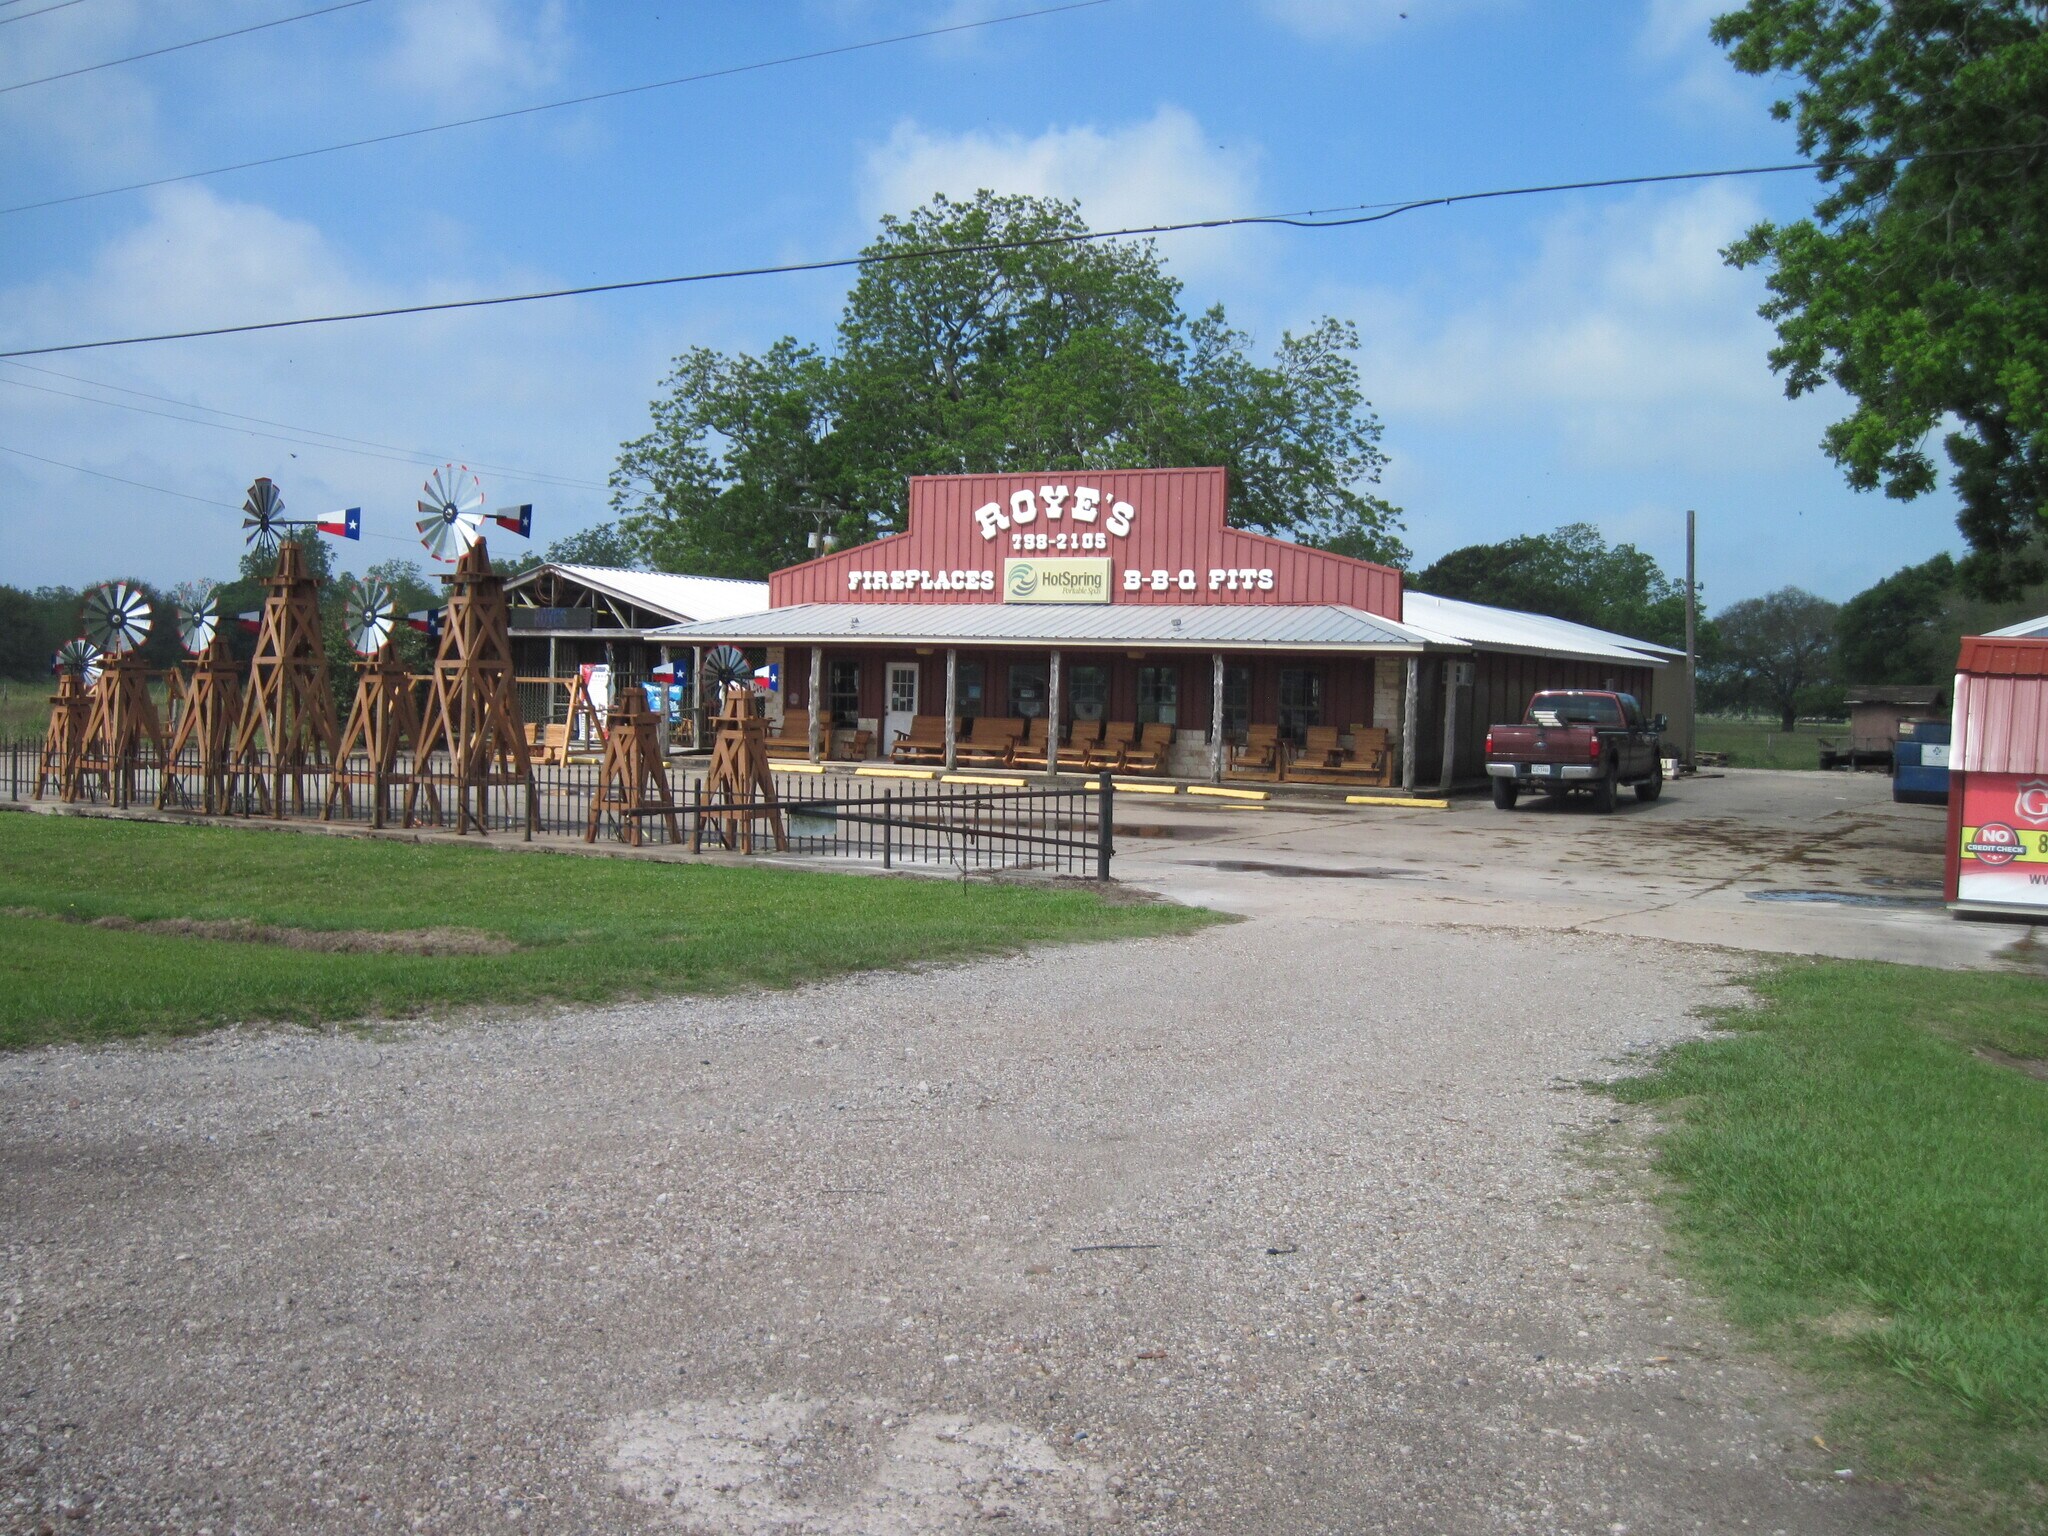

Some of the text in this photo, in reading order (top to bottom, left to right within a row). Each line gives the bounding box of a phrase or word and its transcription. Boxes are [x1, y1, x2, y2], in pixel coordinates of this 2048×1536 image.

[975, 485, 1135, 540] ROYE'S
[1011, 532, 1107, 550] 798-2105
[848, 568, 995, 590] FIREPLACES
[1042, 571, 1102, 588] HotSpring
[1123, 568, 1273, 590] B-B-Q PITS
[1982, 829, 2009, 842] NO
[1967, 844, 1996, 852] CREDIT
